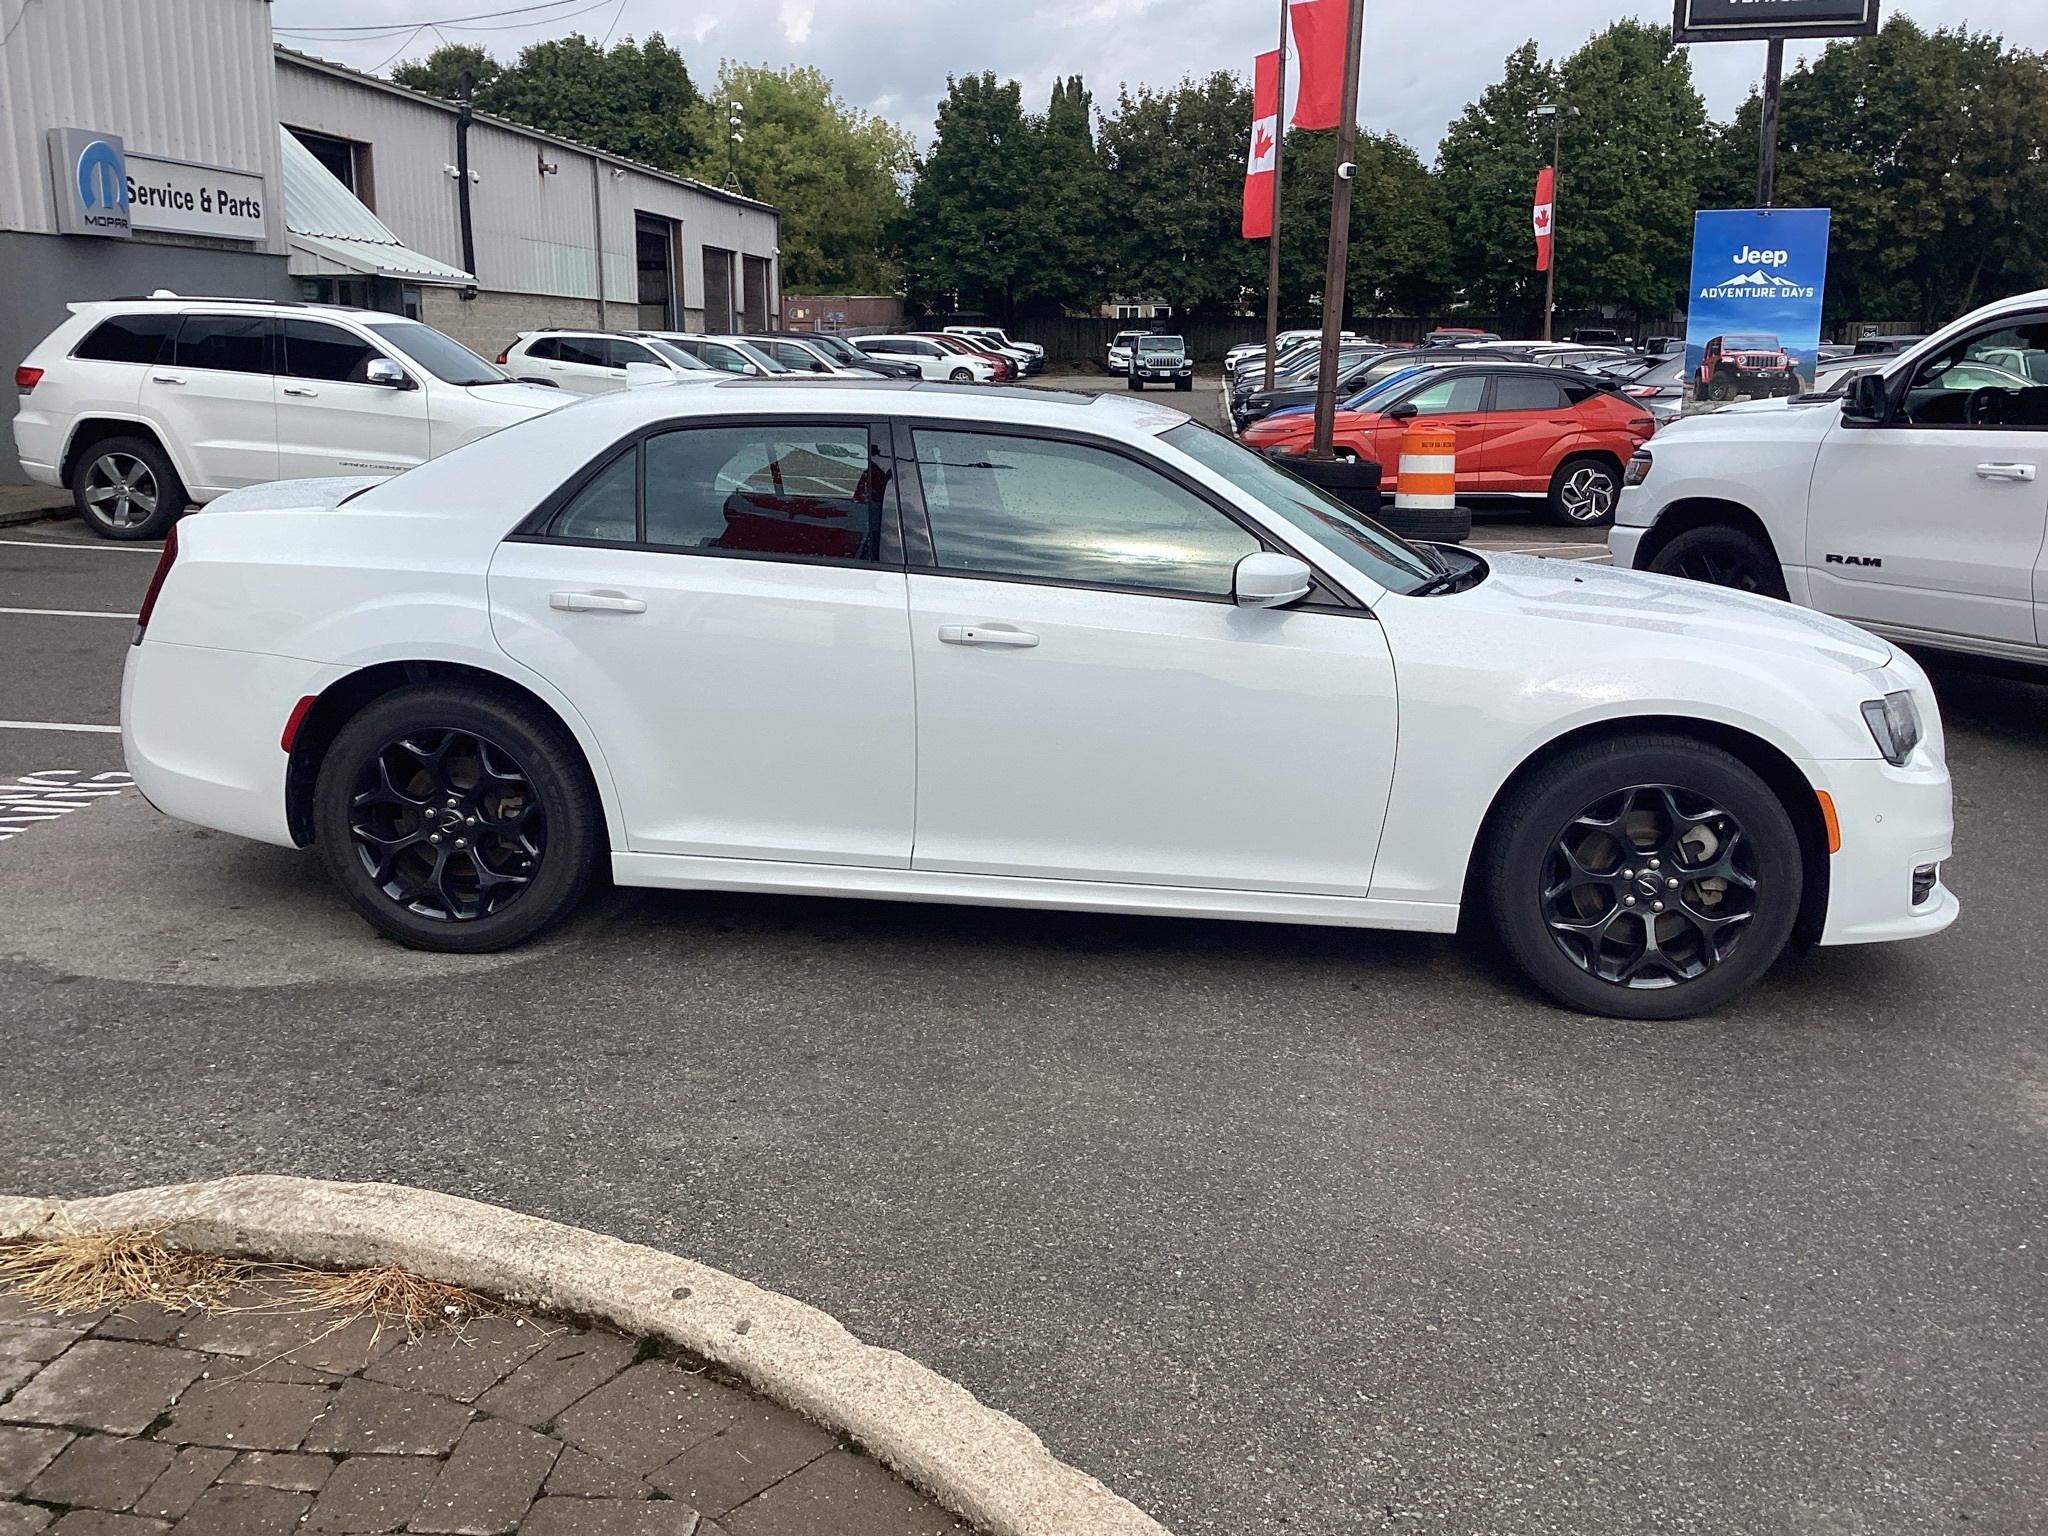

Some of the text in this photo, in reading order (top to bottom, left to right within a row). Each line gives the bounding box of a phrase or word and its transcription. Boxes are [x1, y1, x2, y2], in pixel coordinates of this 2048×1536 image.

[126, 176, 261, 219] Service & Parts
[84, 214, 129, 230] MOPAR
[1732, 246, 1788, 267] Jeep
[1699, 287, 1814, 299] ADVENTURE DAYS
[1825, 554, 1882, 567] RAM
